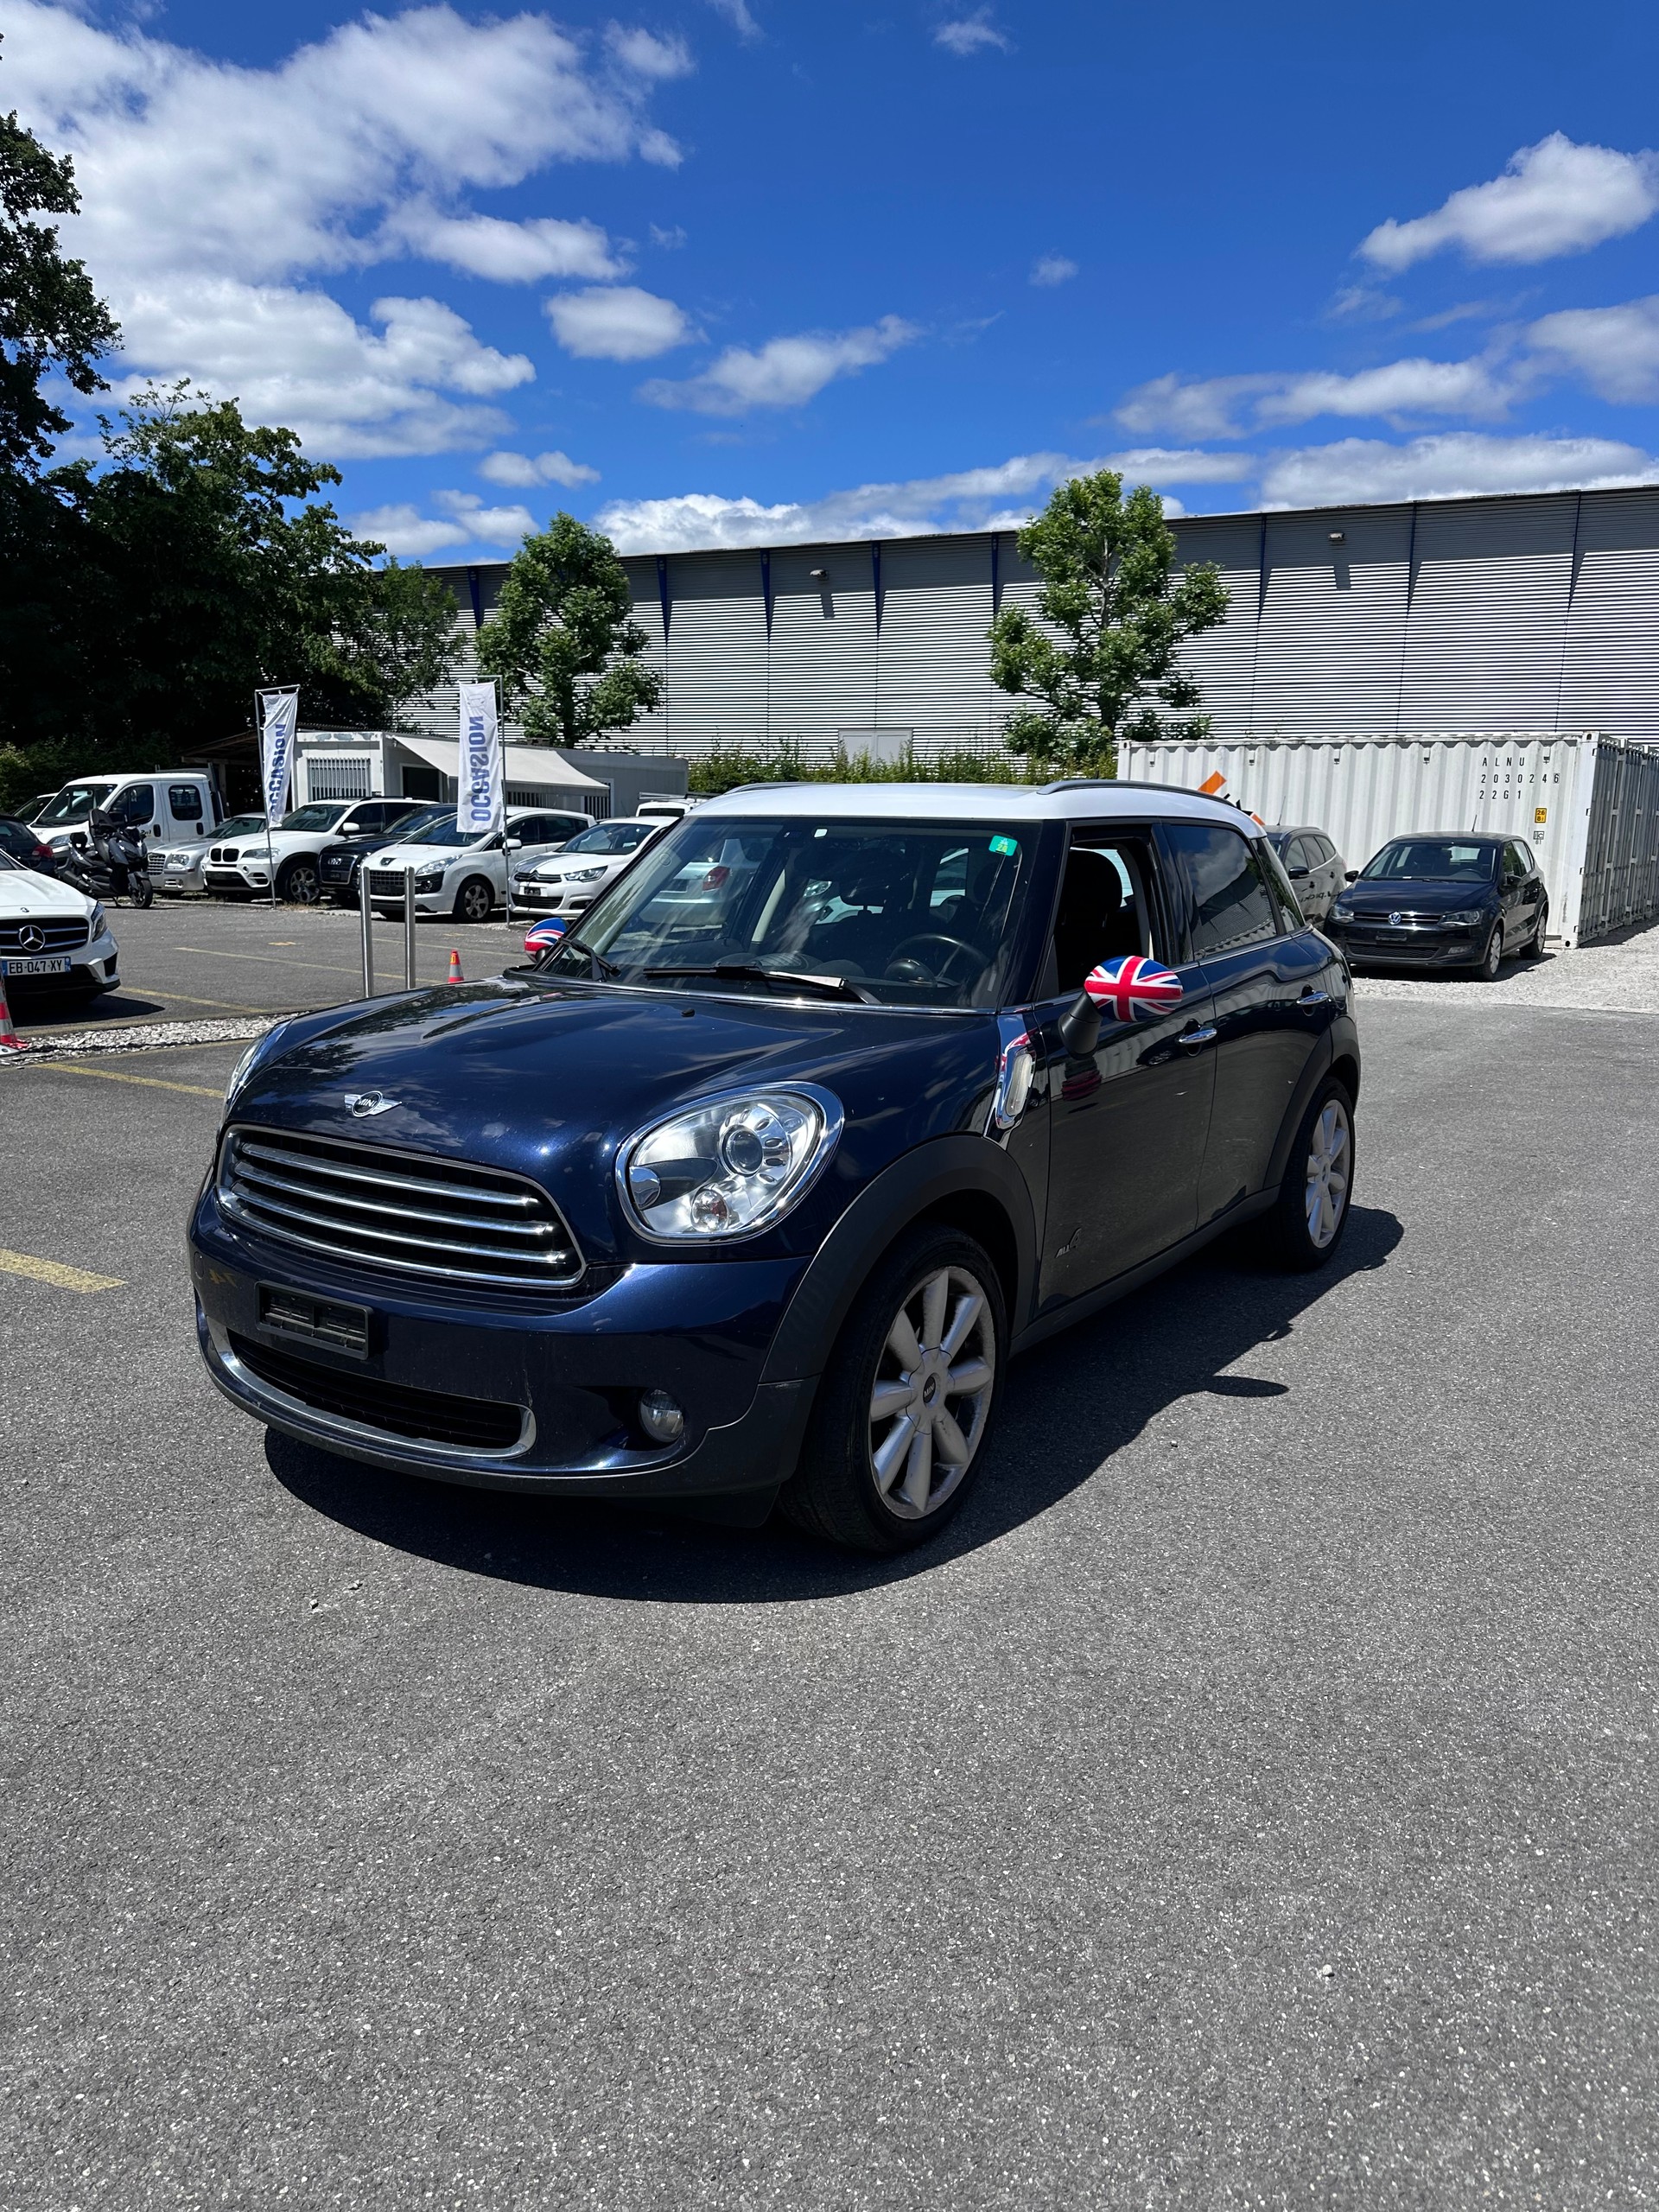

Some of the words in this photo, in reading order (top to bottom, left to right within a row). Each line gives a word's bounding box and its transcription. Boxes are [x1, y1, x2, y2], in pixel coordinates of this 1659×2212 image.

[1482, 757, 1525, 766] ALNU
[1480, 773, 1560, 784] 2030246
[1479, 790, 1522, 799] 22G1
[9, 959, 62, 975] EB-047-XY
